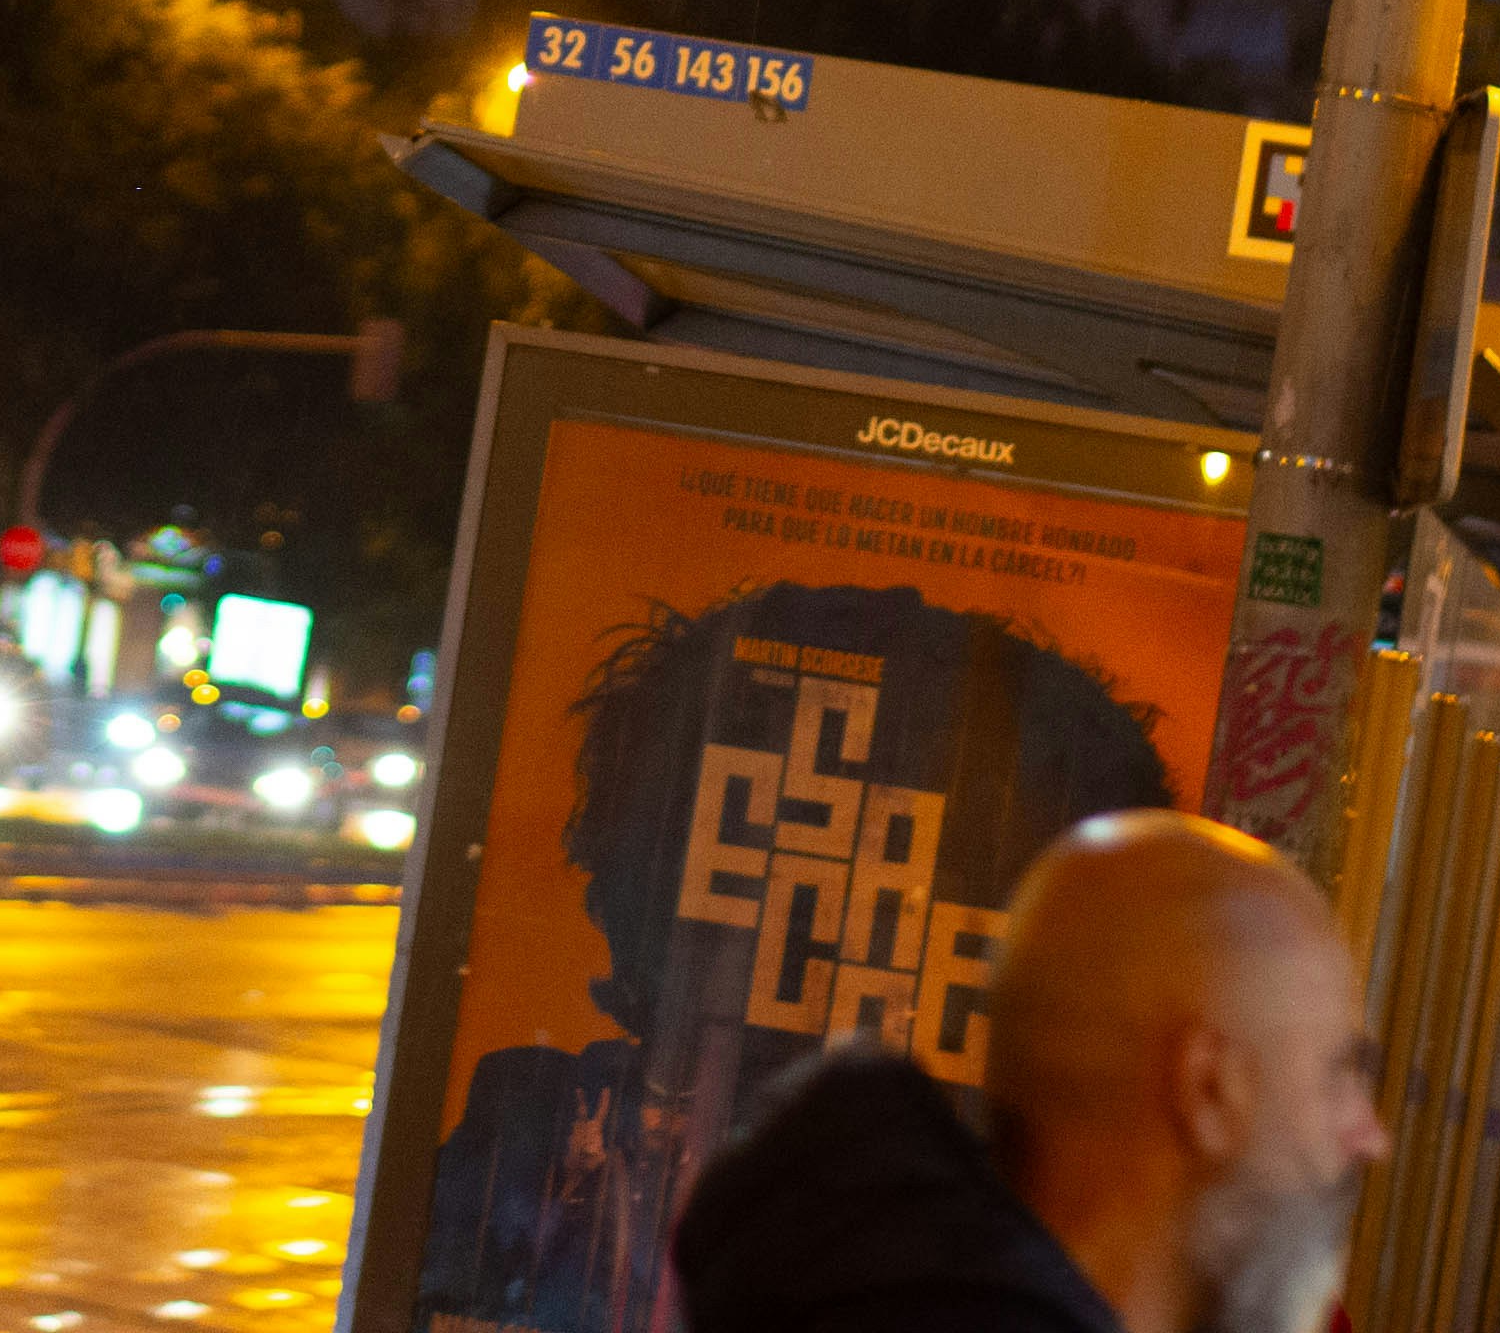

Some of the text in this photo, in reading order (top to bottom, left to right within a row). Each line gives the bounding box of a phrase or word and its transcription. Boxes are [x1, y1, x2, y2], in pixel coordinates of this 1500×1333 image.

[538, 25, 804, 102] 32 56 143 156
[857, 415, 1016, 465] JCDecaux
